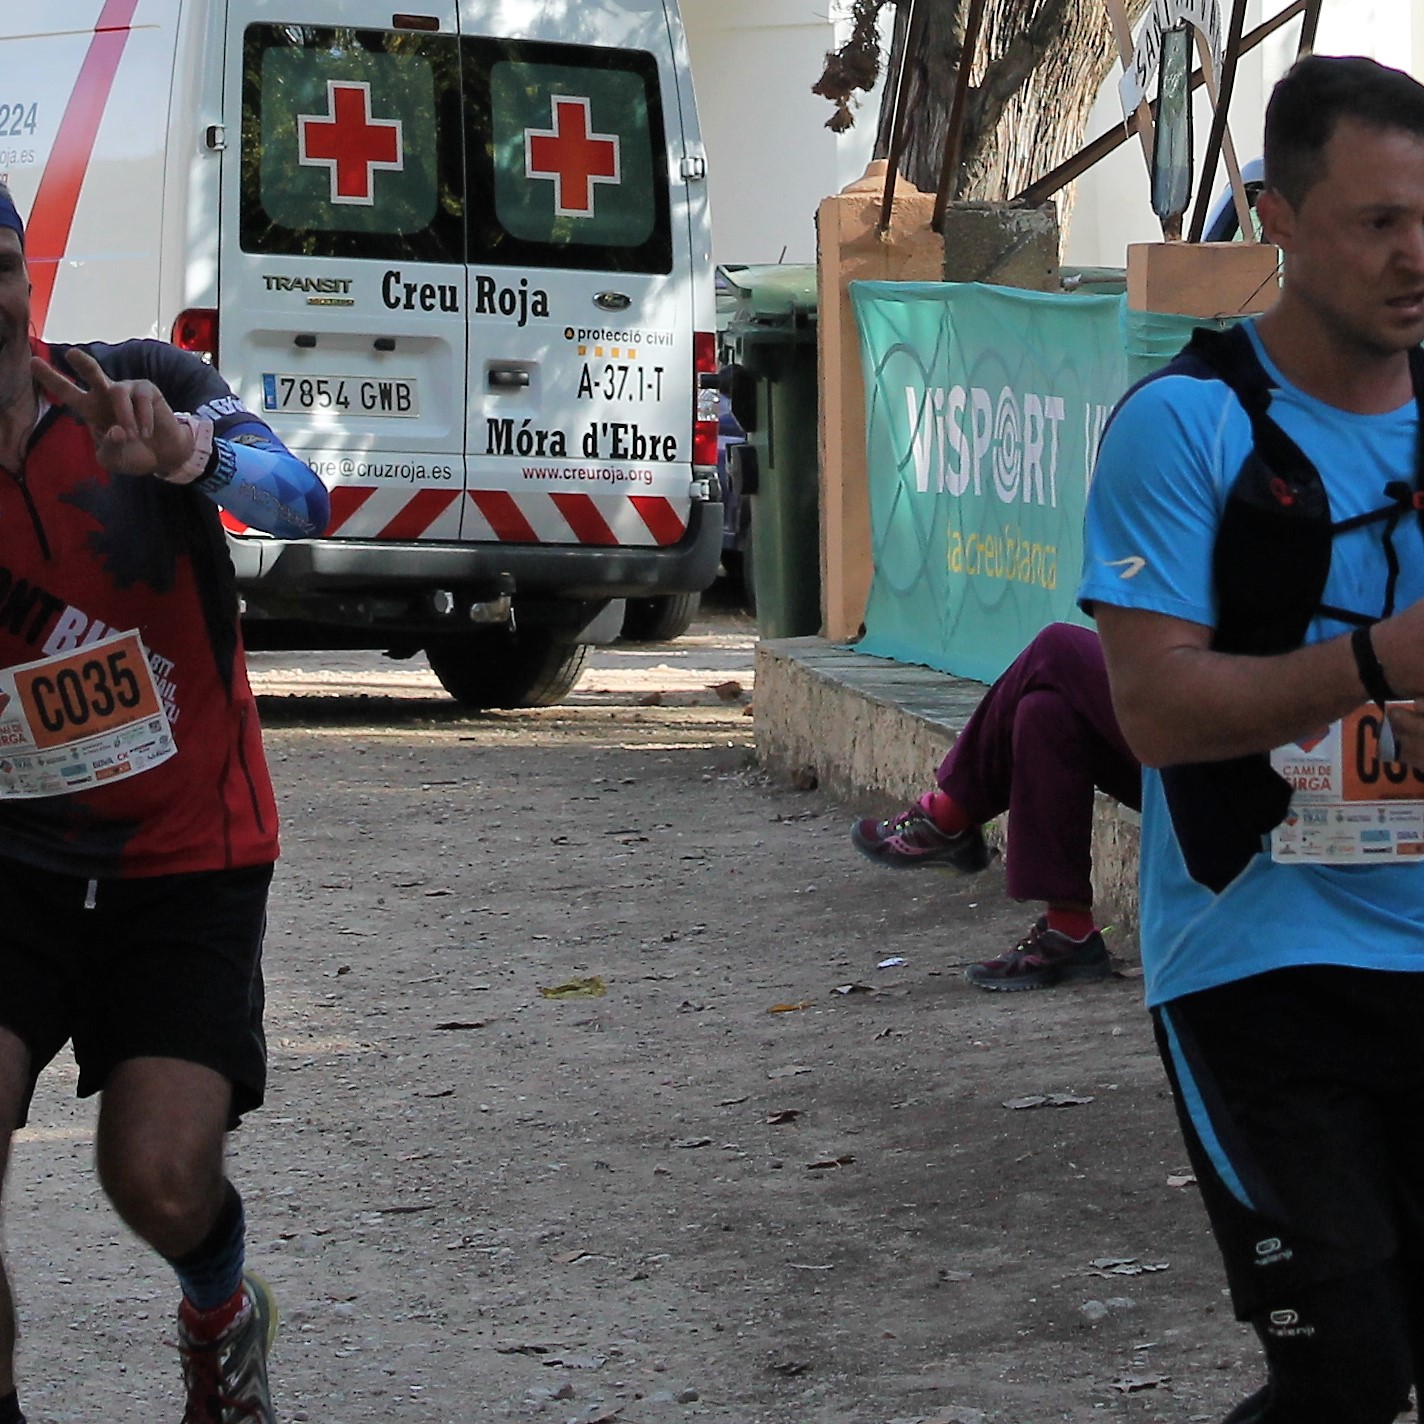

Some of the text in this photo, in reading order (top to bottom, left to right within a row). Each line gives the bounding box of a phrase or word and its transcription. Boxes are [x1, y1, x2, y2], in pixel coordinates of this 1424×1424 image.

[262, 275, 353, 294] TRANSIT
[382, 270, 550, 328] Creu Roja
[577, 327, 674, 346] protecció civil
[280, 378, 350, 409] 7854
[360, 381, 412, 412] GWB
[577, 362, 664, 402] A-37.1-T
[486, 418, 677, 462] Móra d'Ebre
[308, 457, 452, 484] bre@cruzroja.es
[522, 466, 653, 485] www.creuroja.org
